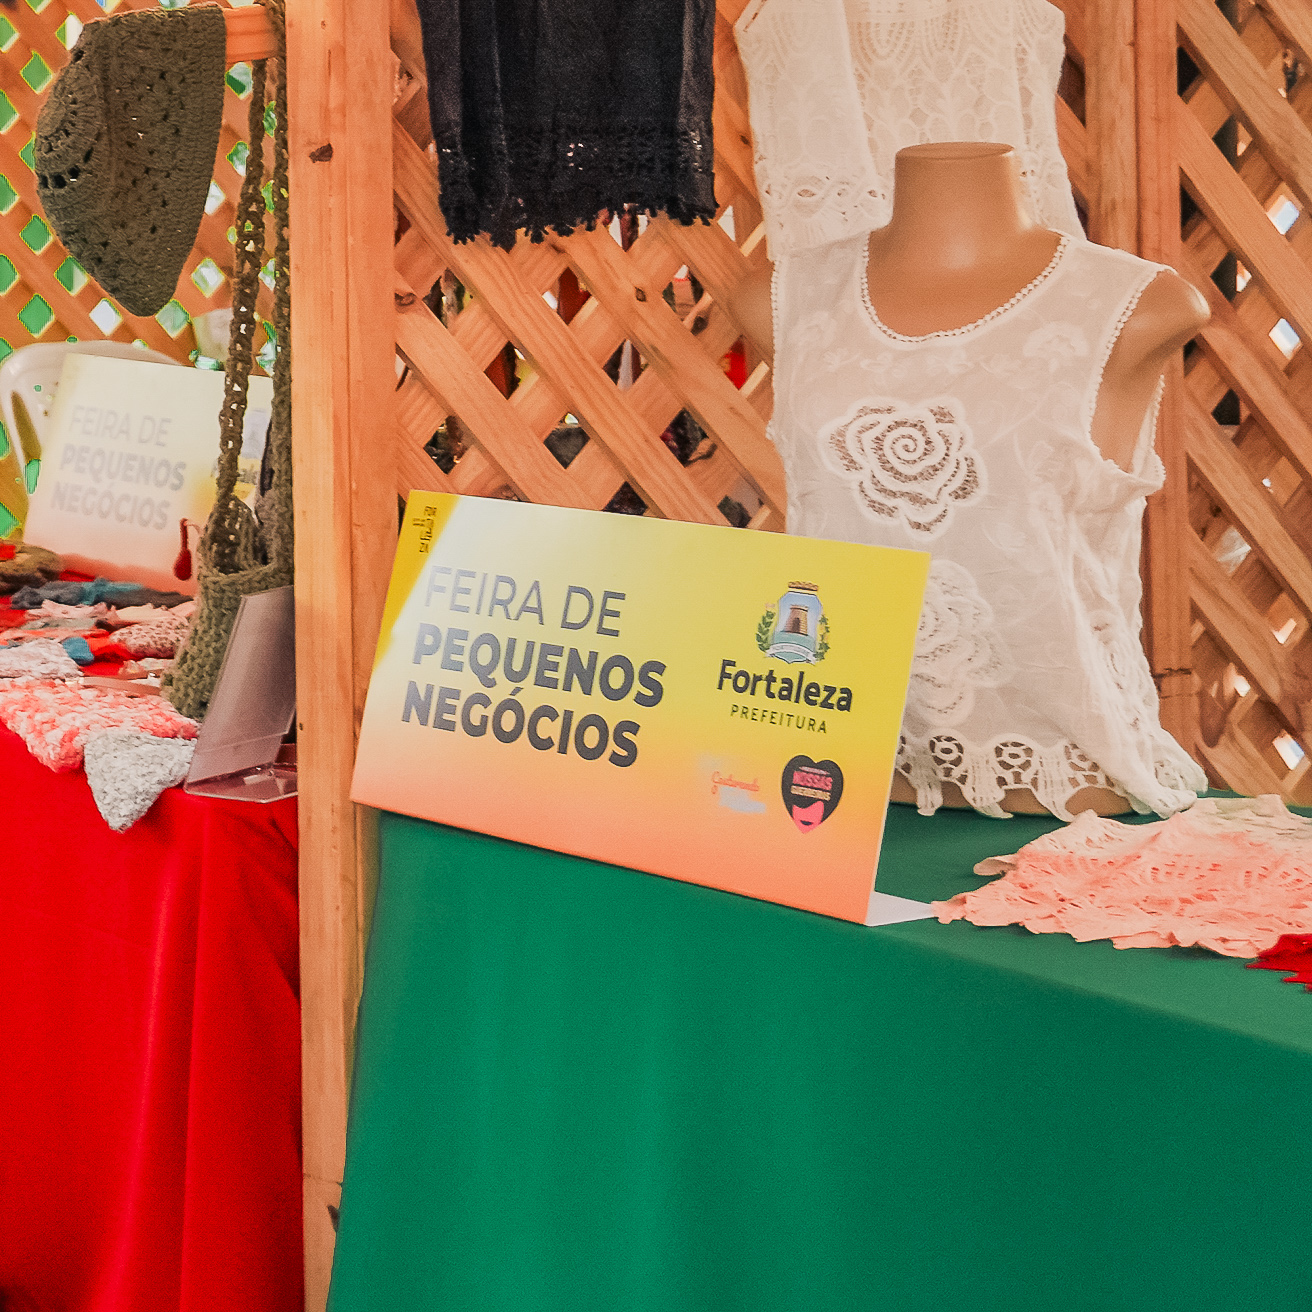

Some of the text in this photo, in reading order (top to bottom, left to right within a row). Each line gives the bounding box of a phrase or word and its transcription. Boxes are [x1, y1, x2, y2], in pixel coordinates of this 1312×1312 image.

[68, 404, 172, 447] FEIRA DE
[59, 442, 187, 492] PEQUENOS
[50, 480, 172, 531] NEGÓCIOS
[425, 564, 627, 638] FEIRA DE
[412, 622, 668, 708] PEQUENOS
[716, 658, 854, 713] Fortaleza
[401, 685, 642, 769] NEGÓCIOS
[729, 703, 828, 735] PREFEITURA
